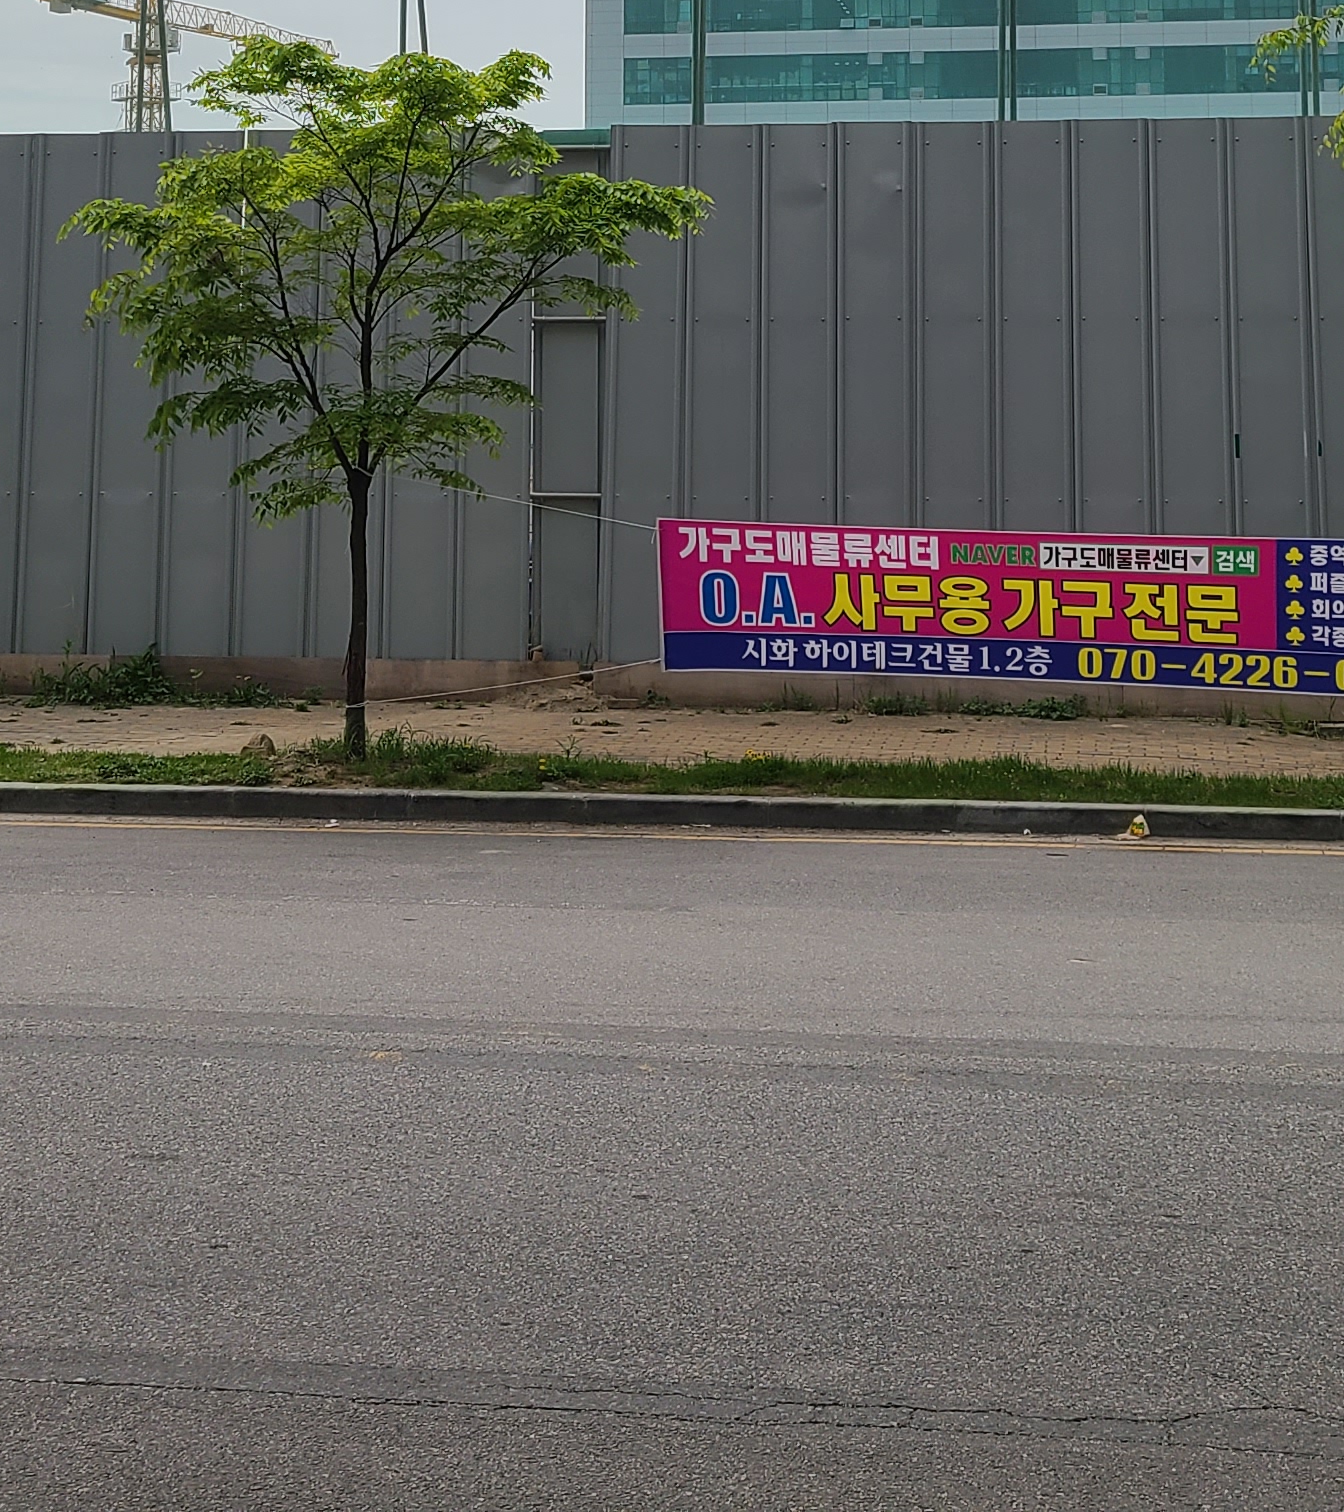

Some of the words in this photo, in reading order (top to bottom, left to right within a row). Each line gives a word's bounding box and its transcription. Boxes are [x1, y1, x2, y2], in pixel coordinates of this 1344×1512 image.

[679, 526, 940, 570] 가구도매물류센터
[951, 543, 1036, 567] NAVER
[1043, 546, 1189, 572] 가구도매물류센터
[1215, 548, 1256, 574] 검색
[699, 570, 816, 628] O.A.
[823, 572, 993, 636] 사무용
[1002, 577, 1240, 645] 가구전문
[742, 637, 798, 668] 시화
